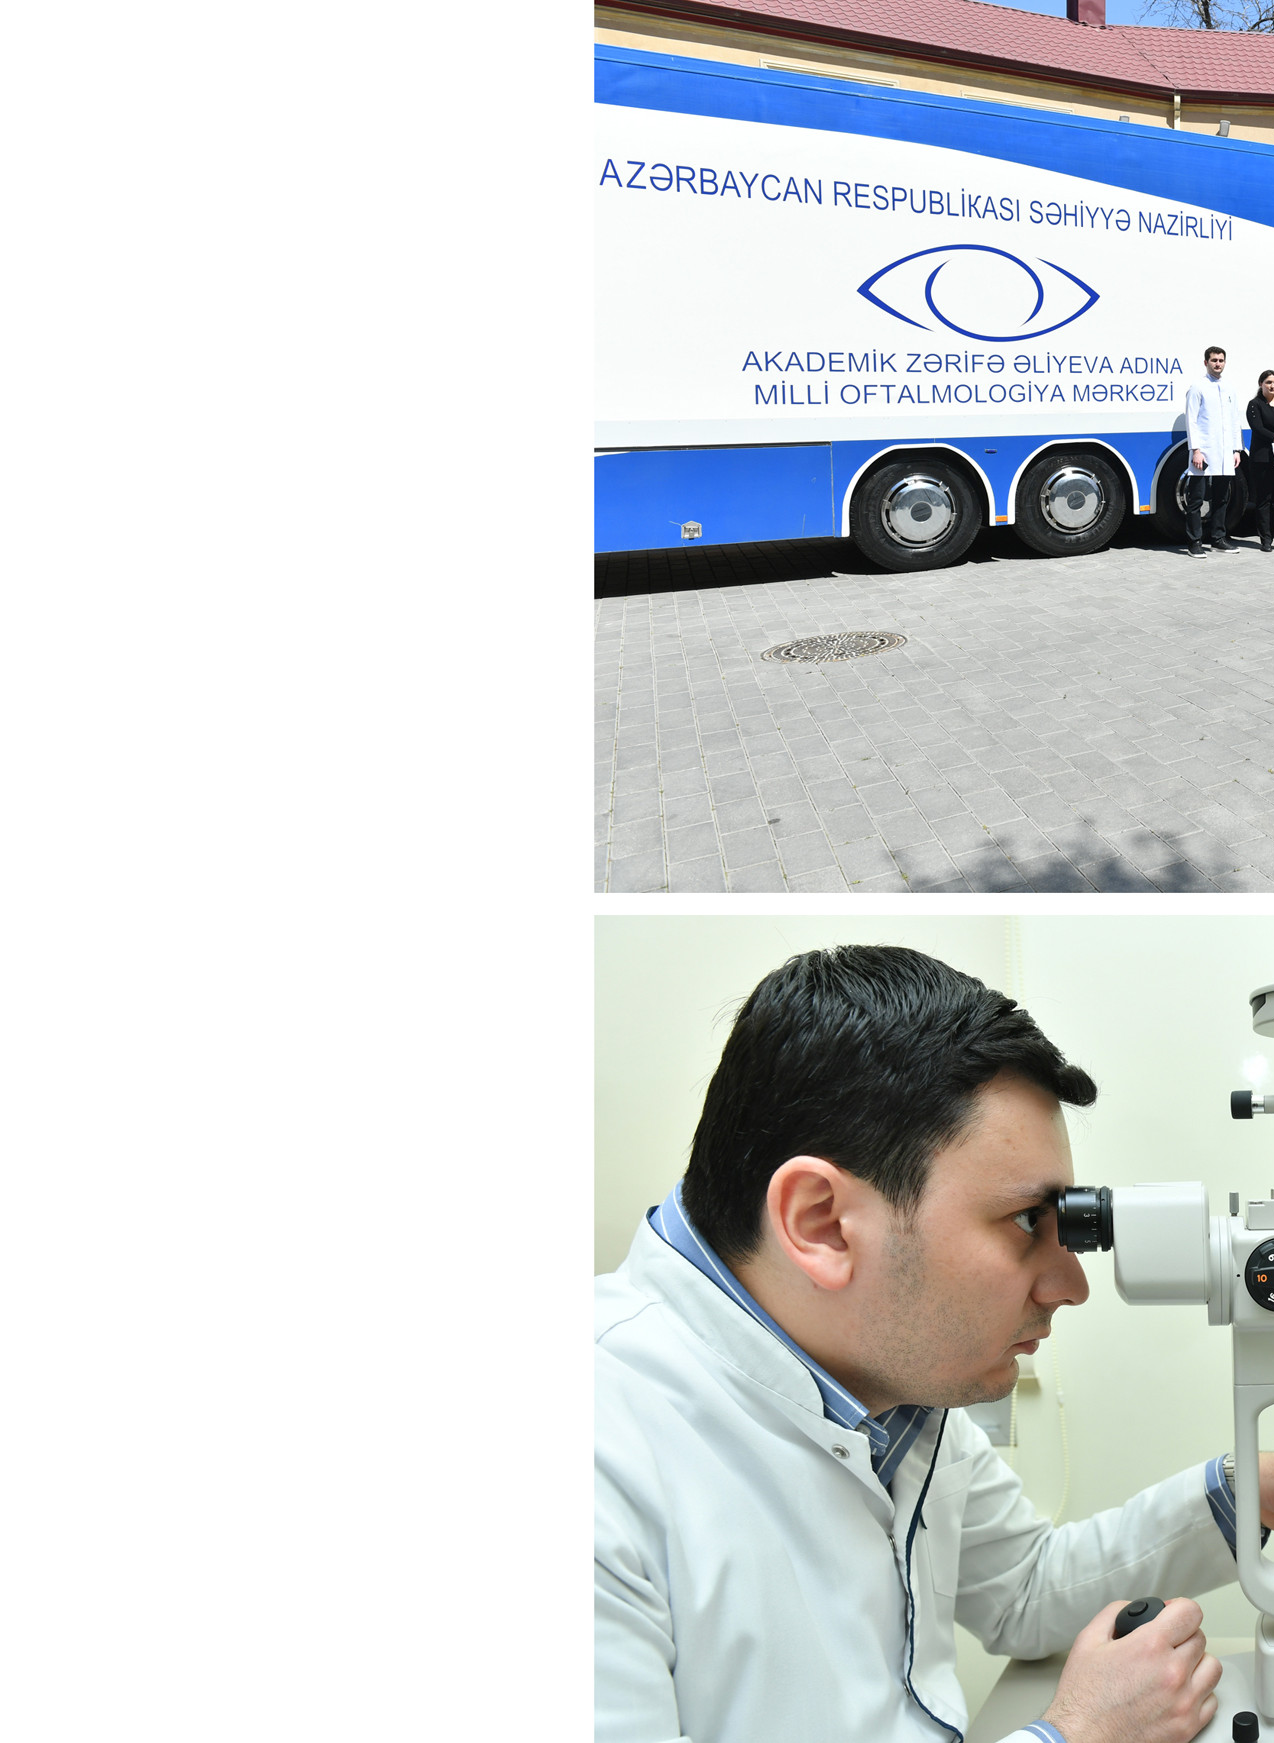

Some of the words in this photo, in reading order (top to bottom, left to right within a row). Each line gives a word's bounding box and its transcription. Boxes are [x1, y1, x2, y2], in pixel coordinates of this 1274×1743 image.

[599, 158, 823, 205] AZƏRBAYCAN
[833, 180, 1021, 222] RESPUBLİKASI
[1029, 200, 1131, 232] SƏHİYYƏ
[1138, 210, 1233, 241] NAZİRLİYİ
[742, 349, 898, 373] AKADEMİK
[906, 350, 1005, 374] ZƏRİFƏ
[1013, 351, 1114, 374] ƏLİYEVA
[1119, 357, 1183, 375] ADINA
[755, 380, 829, 405] MİLLİ
[840, 380, 1066, 405] OFTALMOLOGİYA
[1073, 381, 1174, 402] MƏRKƏZİ
[1256, 1274, 1268, 1283] 10
